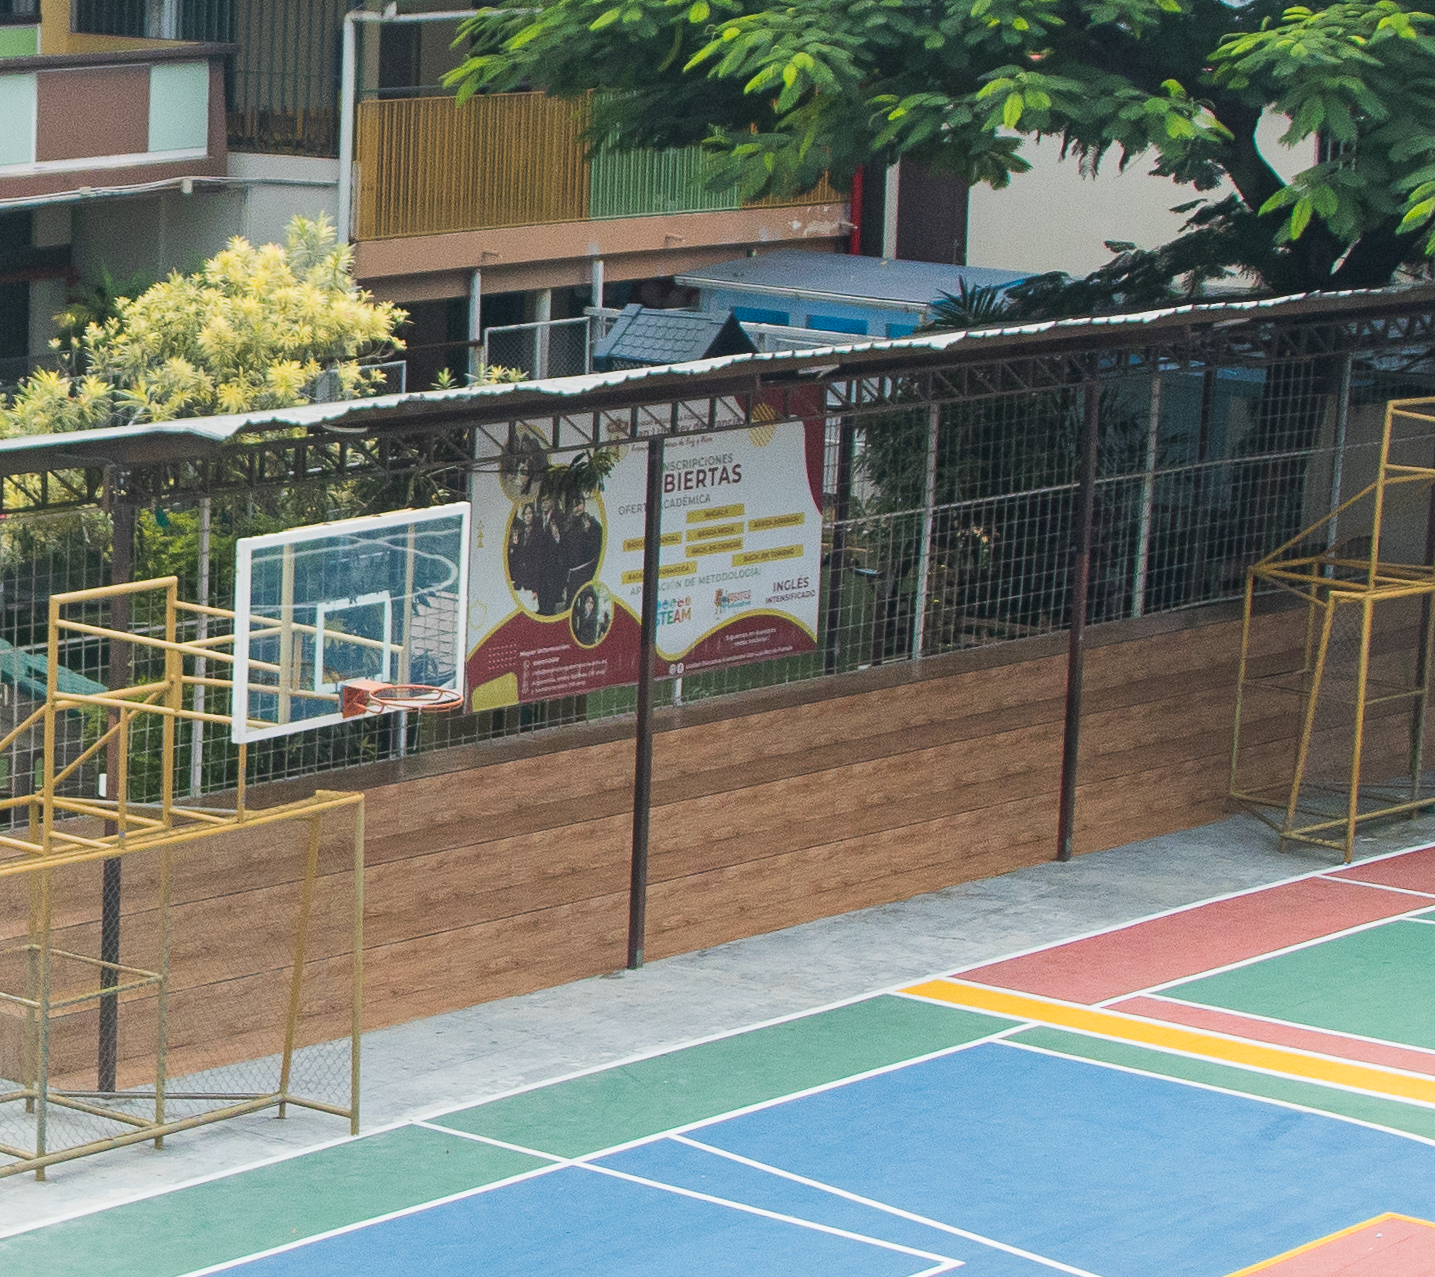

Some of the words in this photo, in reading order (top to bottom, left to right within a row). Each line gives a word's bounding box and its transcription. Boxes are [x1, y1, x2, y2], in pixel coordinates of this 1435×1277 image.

[662, 453, 734, 471] NSCRIPCIONES
[663, 463, 743, 493] BIERTAS
[618, 501, 646, 516] OFERT
[765, 589, 816, 604] INTENSIFICADO
